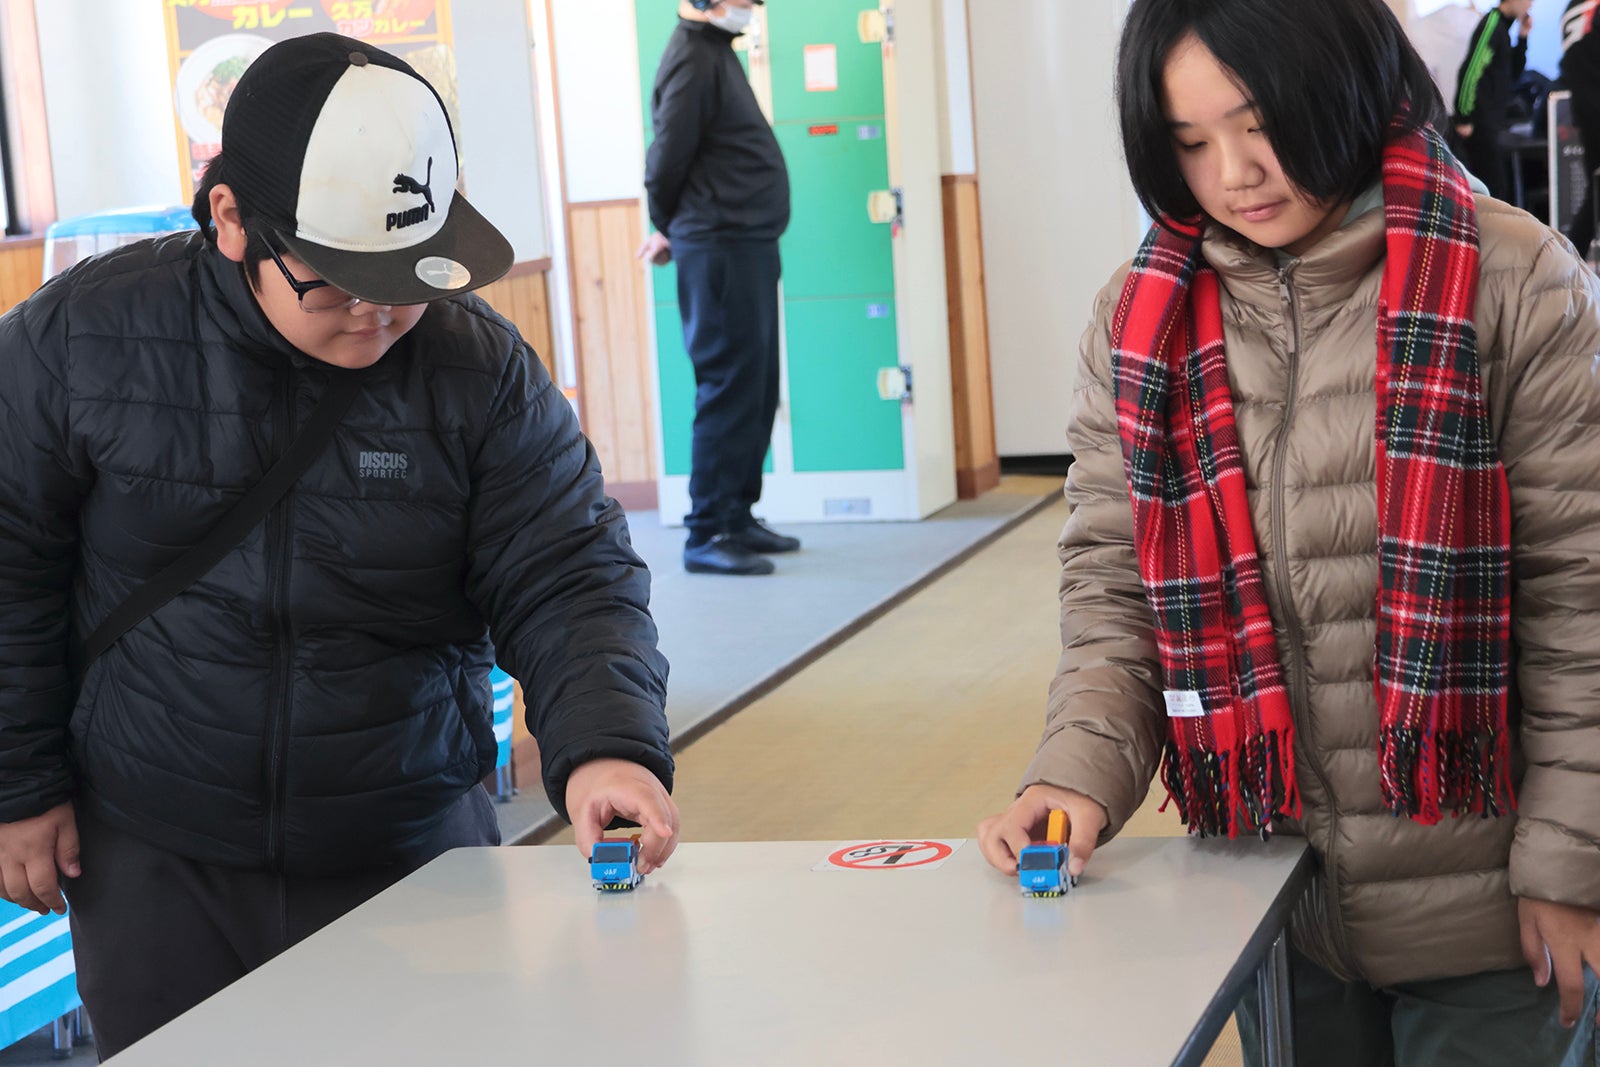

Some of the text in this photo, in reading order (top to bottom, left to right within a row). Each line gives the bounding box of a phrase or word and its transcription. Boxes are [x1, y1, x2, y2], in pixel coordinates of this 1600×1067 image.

[232, 3, 313, 29] カレー
[386, 203, 429, 232] PUMA
[360, 451, 408, 469] DISCUS
[360, 469, 407, 479] SPORTEC
